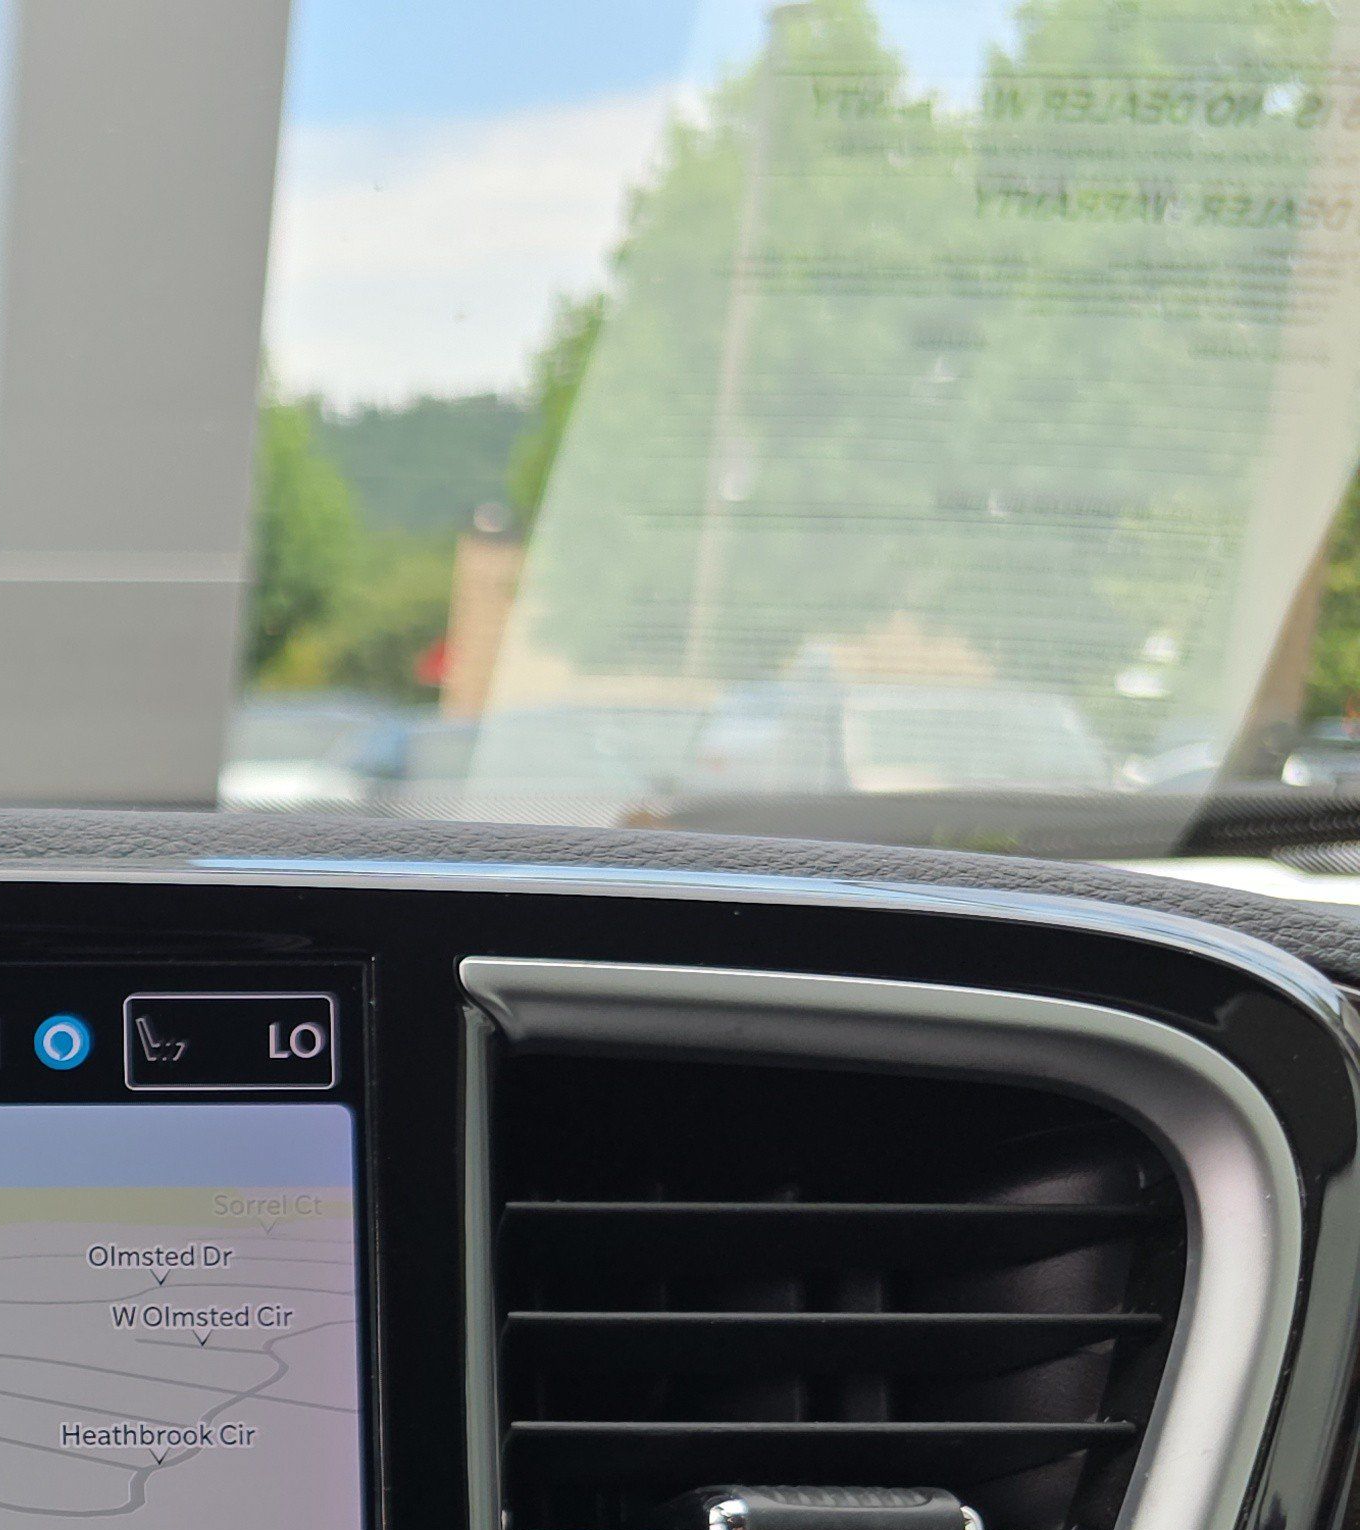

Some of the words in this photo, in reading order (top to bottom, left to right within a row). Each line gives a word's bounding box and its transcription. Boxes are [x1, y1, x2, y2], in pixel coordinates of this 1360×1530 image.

[267, 1023, 324, 1062] LO
[214, 1194, 287, 1216] Sorrel
[296, 1194, 323, 1216] Ct
[87, 1244, 195, 1270] Olmsted
[204, 1245, 233, 1269] Dr
[112, 1305, 138, 1328] W
[142, 1304, 249, 1329] Olmsted
[257, 1304, 293, 1329] Cir
[62, 1423, 213, 1449] Heathbrook
[219, 1423, 256, 1448] Cir
